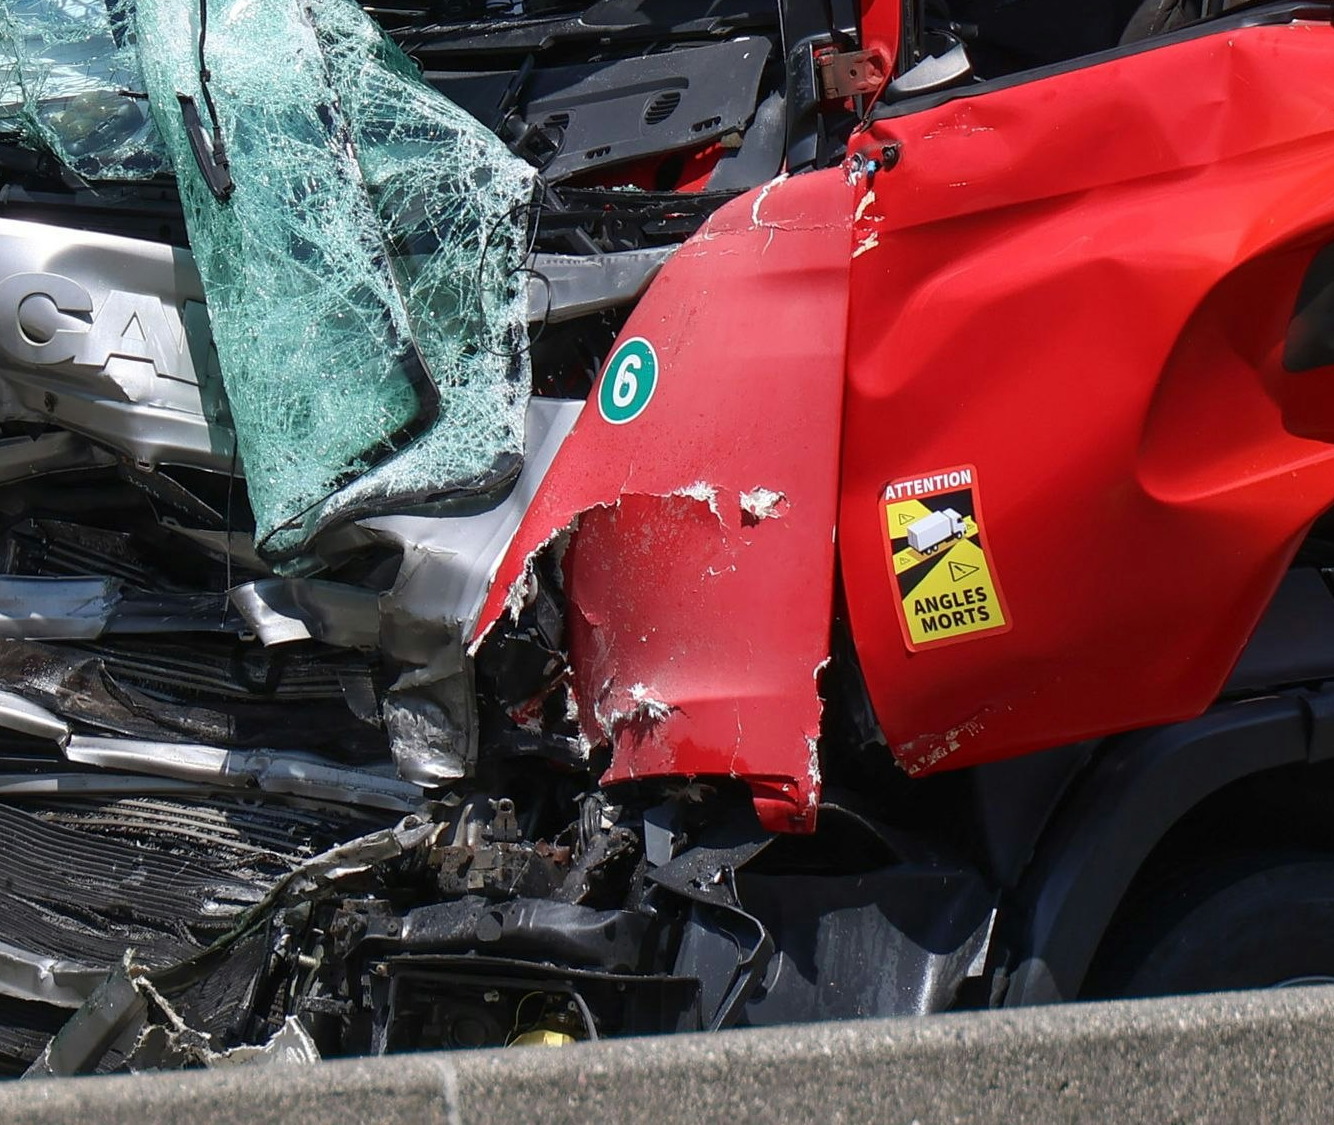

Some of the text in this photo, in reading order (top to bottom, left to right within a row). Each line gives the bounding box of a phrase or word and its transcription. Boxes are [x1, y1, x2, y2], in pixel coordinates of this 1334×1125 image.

[612, 354, 642, 408] 6
[885, 469, 972, 501] ATTENTION
[914, 586, 988, 616] ANGLES
[921, 606, 990, 634] MORTS
